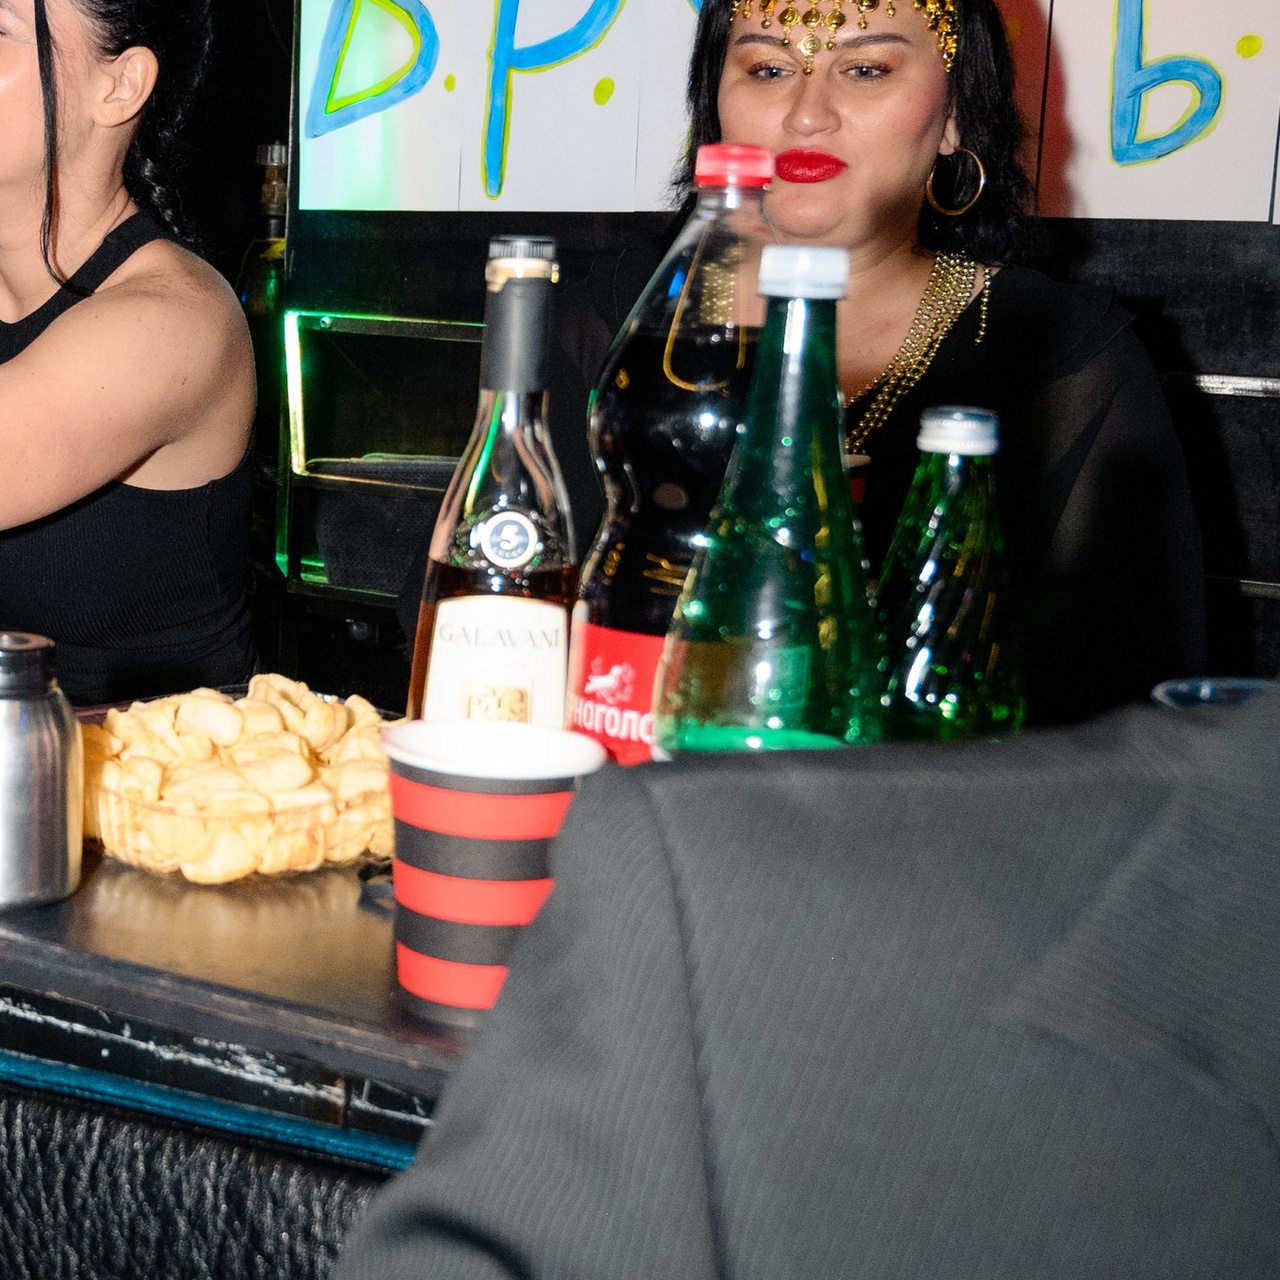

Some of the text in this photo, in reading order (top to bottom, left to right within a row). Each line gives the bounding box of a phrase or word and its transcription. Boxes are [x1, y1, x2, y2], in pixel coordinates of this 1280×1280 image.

[499, 524, 520, 550] 5
[438, 623, 560, 649] GALAVANI
[573, 696, 655, 743] НОГОЛО
